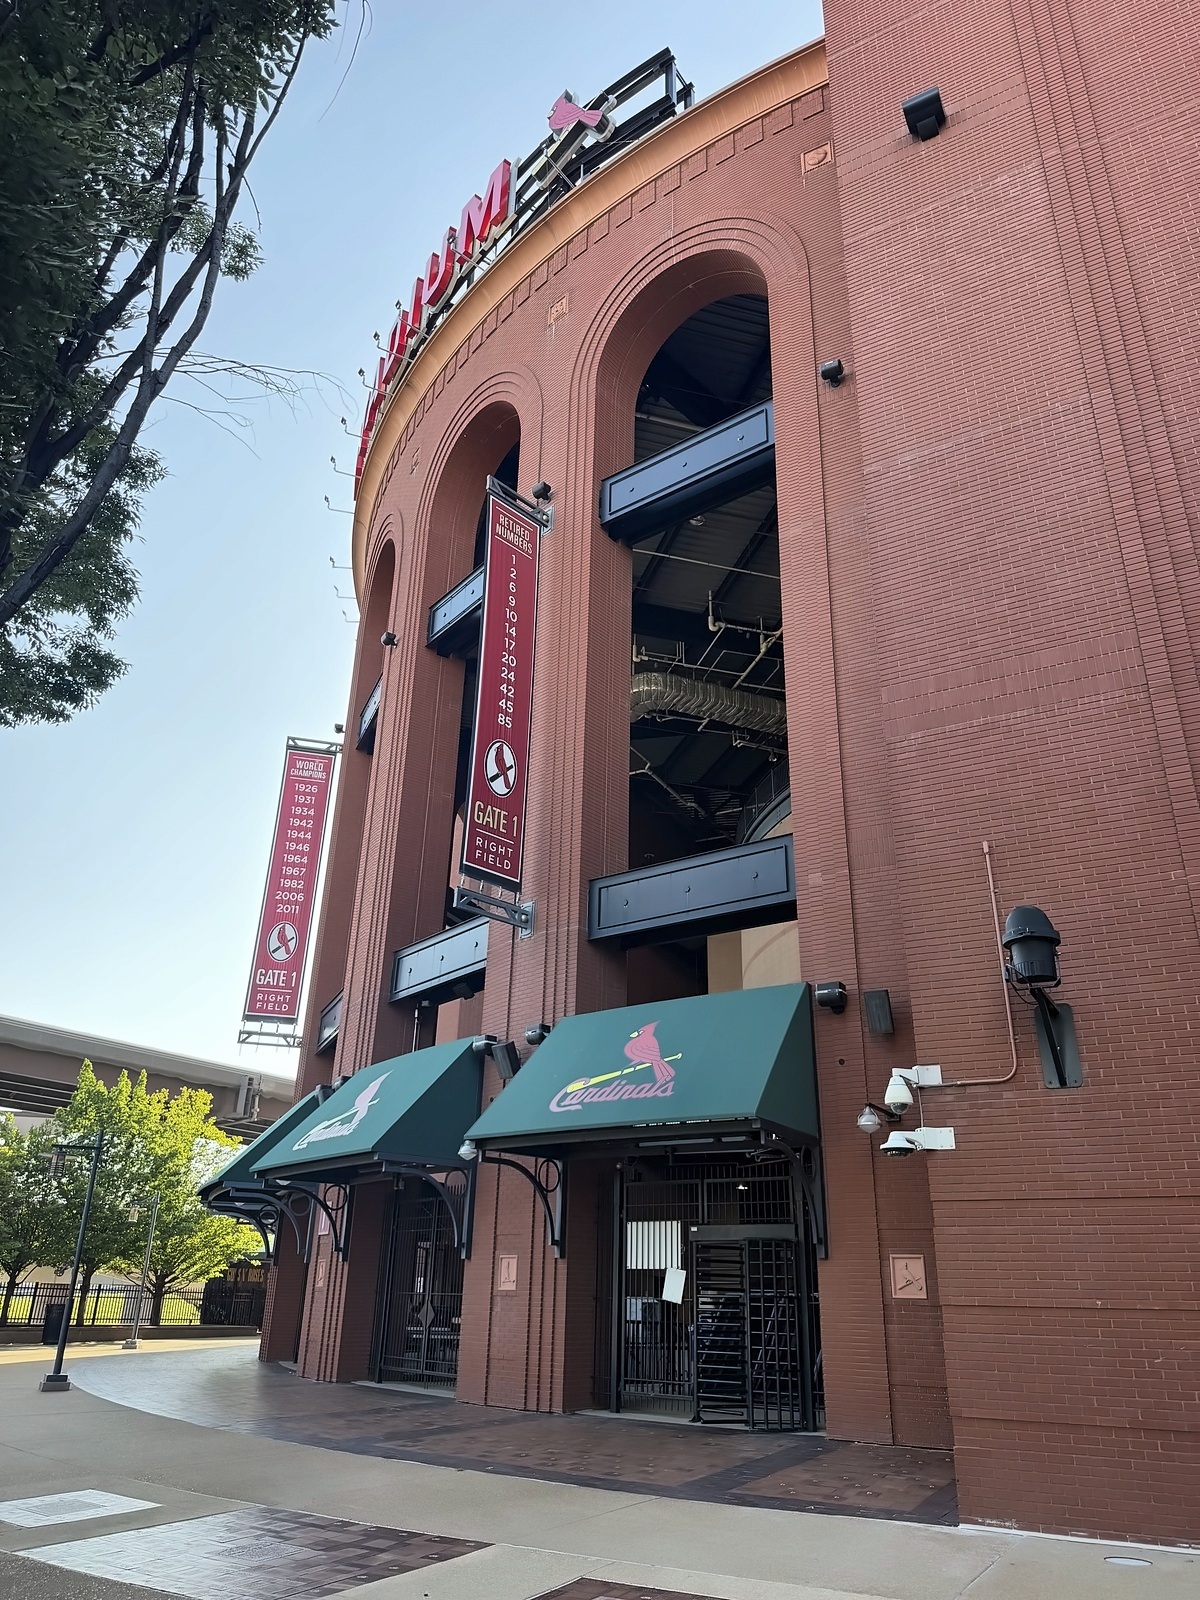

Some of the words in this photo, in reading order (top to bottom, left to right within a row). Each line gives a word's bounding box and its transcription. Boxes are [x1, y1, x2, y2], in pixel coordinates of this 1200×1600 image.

[500, 514, 530, 541] RETIRED
[496, 523, 533, 554] NUMBERS
[511, 554, 516, 565] 1
[510, 568, 517, 580] 2
[509, 582, 517, 593] 6
[508, 596, 516, 607] 9
[505, 608, 518, 623] 10
[505, 623, 516, 637] 14
[505, 638, 516, 650] 17
[501, 652, 517, 667] 20
[501, 667, 515, 682] 24
[500, 683, 515, 697] 42
[499, 699, 514, 713] 45
[498, 714, 512, 728] 85
[296, 760, 324, 772] WORLD
[290, 768, 327, 779] CHAMPIONS
[294, 783, 318, 793] 1926
[294, 795, 315, 804] 1931
[291, 806, 315, 816] 1934
[289, 818, 314, 828] 1942
[474, 801, 508, 833] GATE
[512, 815, 518, 837] 1
[287, 830, 312, 840] 1944
[285, 842, 310, 852] 1946
[476, 837, 513, 858] RIGHT
[283, 854, 308, 864] 1964
[475, 851, 511, 870] FIELD
[281, 866, 306, 876] 1967
[280, 878, 304, 888] 1982
[275, 891, 304, 902] 2006
[276, 904, 300, 914] 2011
[256, 968, 287, 987] GATE
[291, 971, 297, 987] 1
[257, 993, 291, 1003] RIGHT
[256, 1002, 289, 1012] FIELD
[549, 1077, 675, 1112] Cardinals
